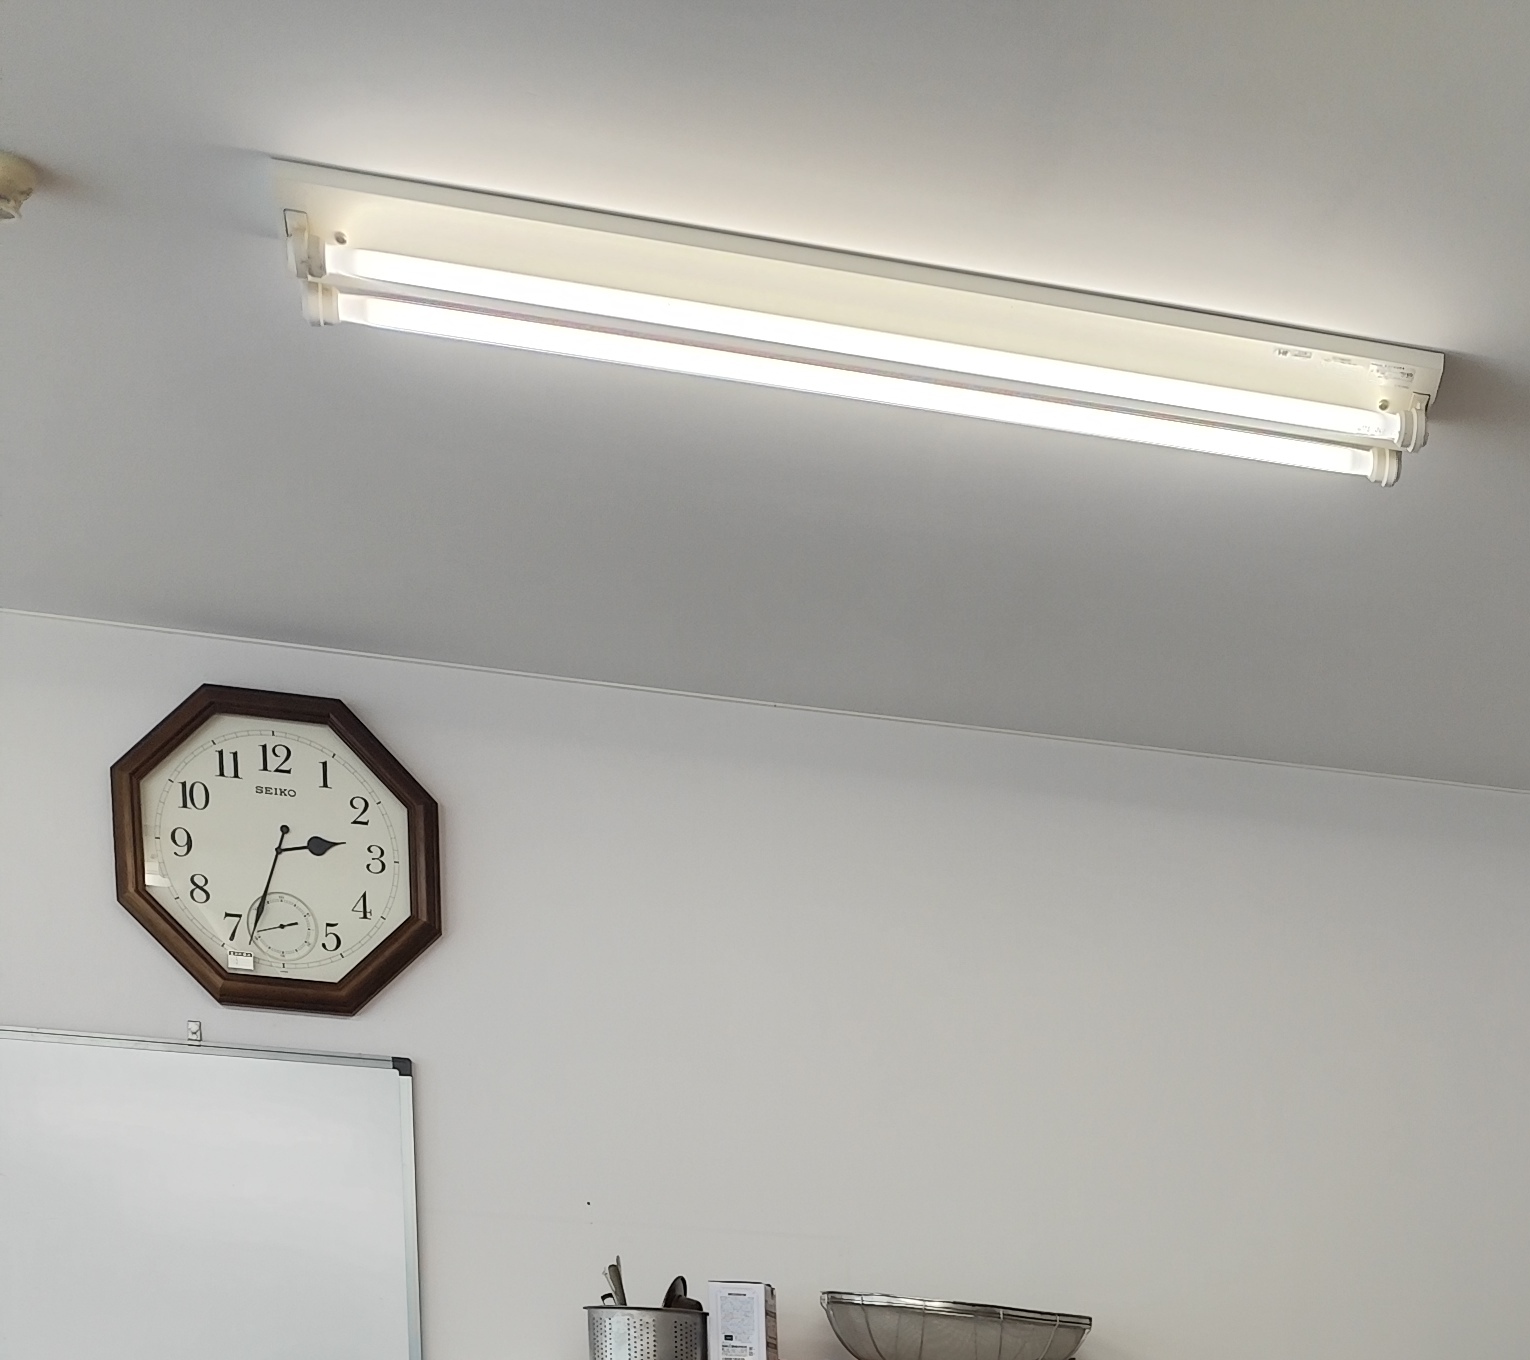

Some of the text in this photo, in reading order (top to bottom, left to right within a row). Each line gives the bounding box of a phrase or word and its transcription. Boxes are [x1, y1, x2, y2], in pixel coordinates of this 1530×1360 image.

[215, 748, 243, 780] 11
[258, 743, 292, 774] 12
[318, 760, 333, 789] 1
[178, 780, 210, 811] 10
[255, 785, 297, 798] SEIKO
[349, 796, 370, 826] 2
[170, 826, 193, 857] 9
[366, 844, 386, 874] 3
[189, 873, 211, 904] 8
[351, 890, 373, 920] 4
[223, 911, 243, 941] 7
[321, 922, 342, 952] 5
